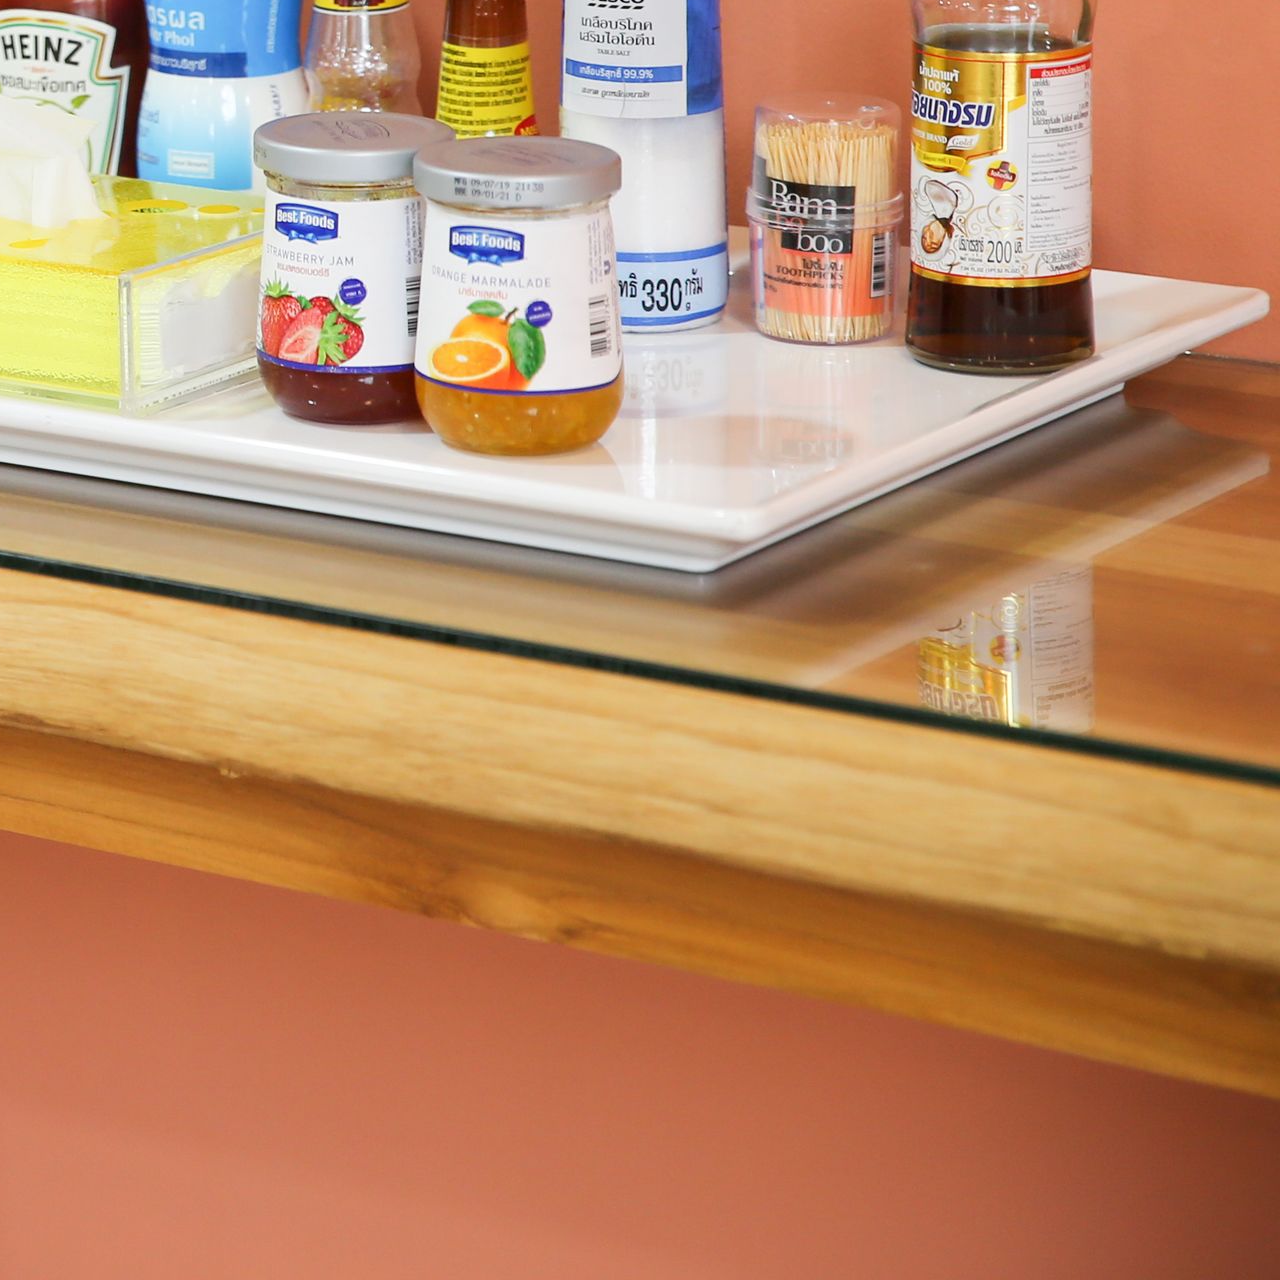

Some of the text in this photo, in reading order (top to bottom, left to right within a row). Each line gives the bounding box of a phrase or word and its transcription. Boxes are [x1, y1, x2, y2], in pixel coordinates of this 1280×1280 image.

[164, 30, 195, 47] Phol
[1, 33, 83, 66] HEINZ
[623, 69, 654, 79] 99.9%
[923, 78, 952, 95] 100%
[912, 94, 993, 128] อยนางรม
[952, 137, 975, 147] Gold
[471, 178, 511, 190] 09/07/19
[471, 189, 510, 201] 09/01/21
[771, 179, 837, 220] Bam
[277, 209, 335, 230] Best Foods
[452, 231, 521, 252] Best Foods
[797, 226, 843, 254] boo
[266, 244, 354, 266] STRAWBERRY JAM
[987, 240, 1012, 263] 200
[432, 265, 551, 289] ORANGE MARMALADE
[776, 264, 844, 281] TOOTHPICKS
[642, 278, 683, 312] 330
[685, 268, 704, 297] กรัม
